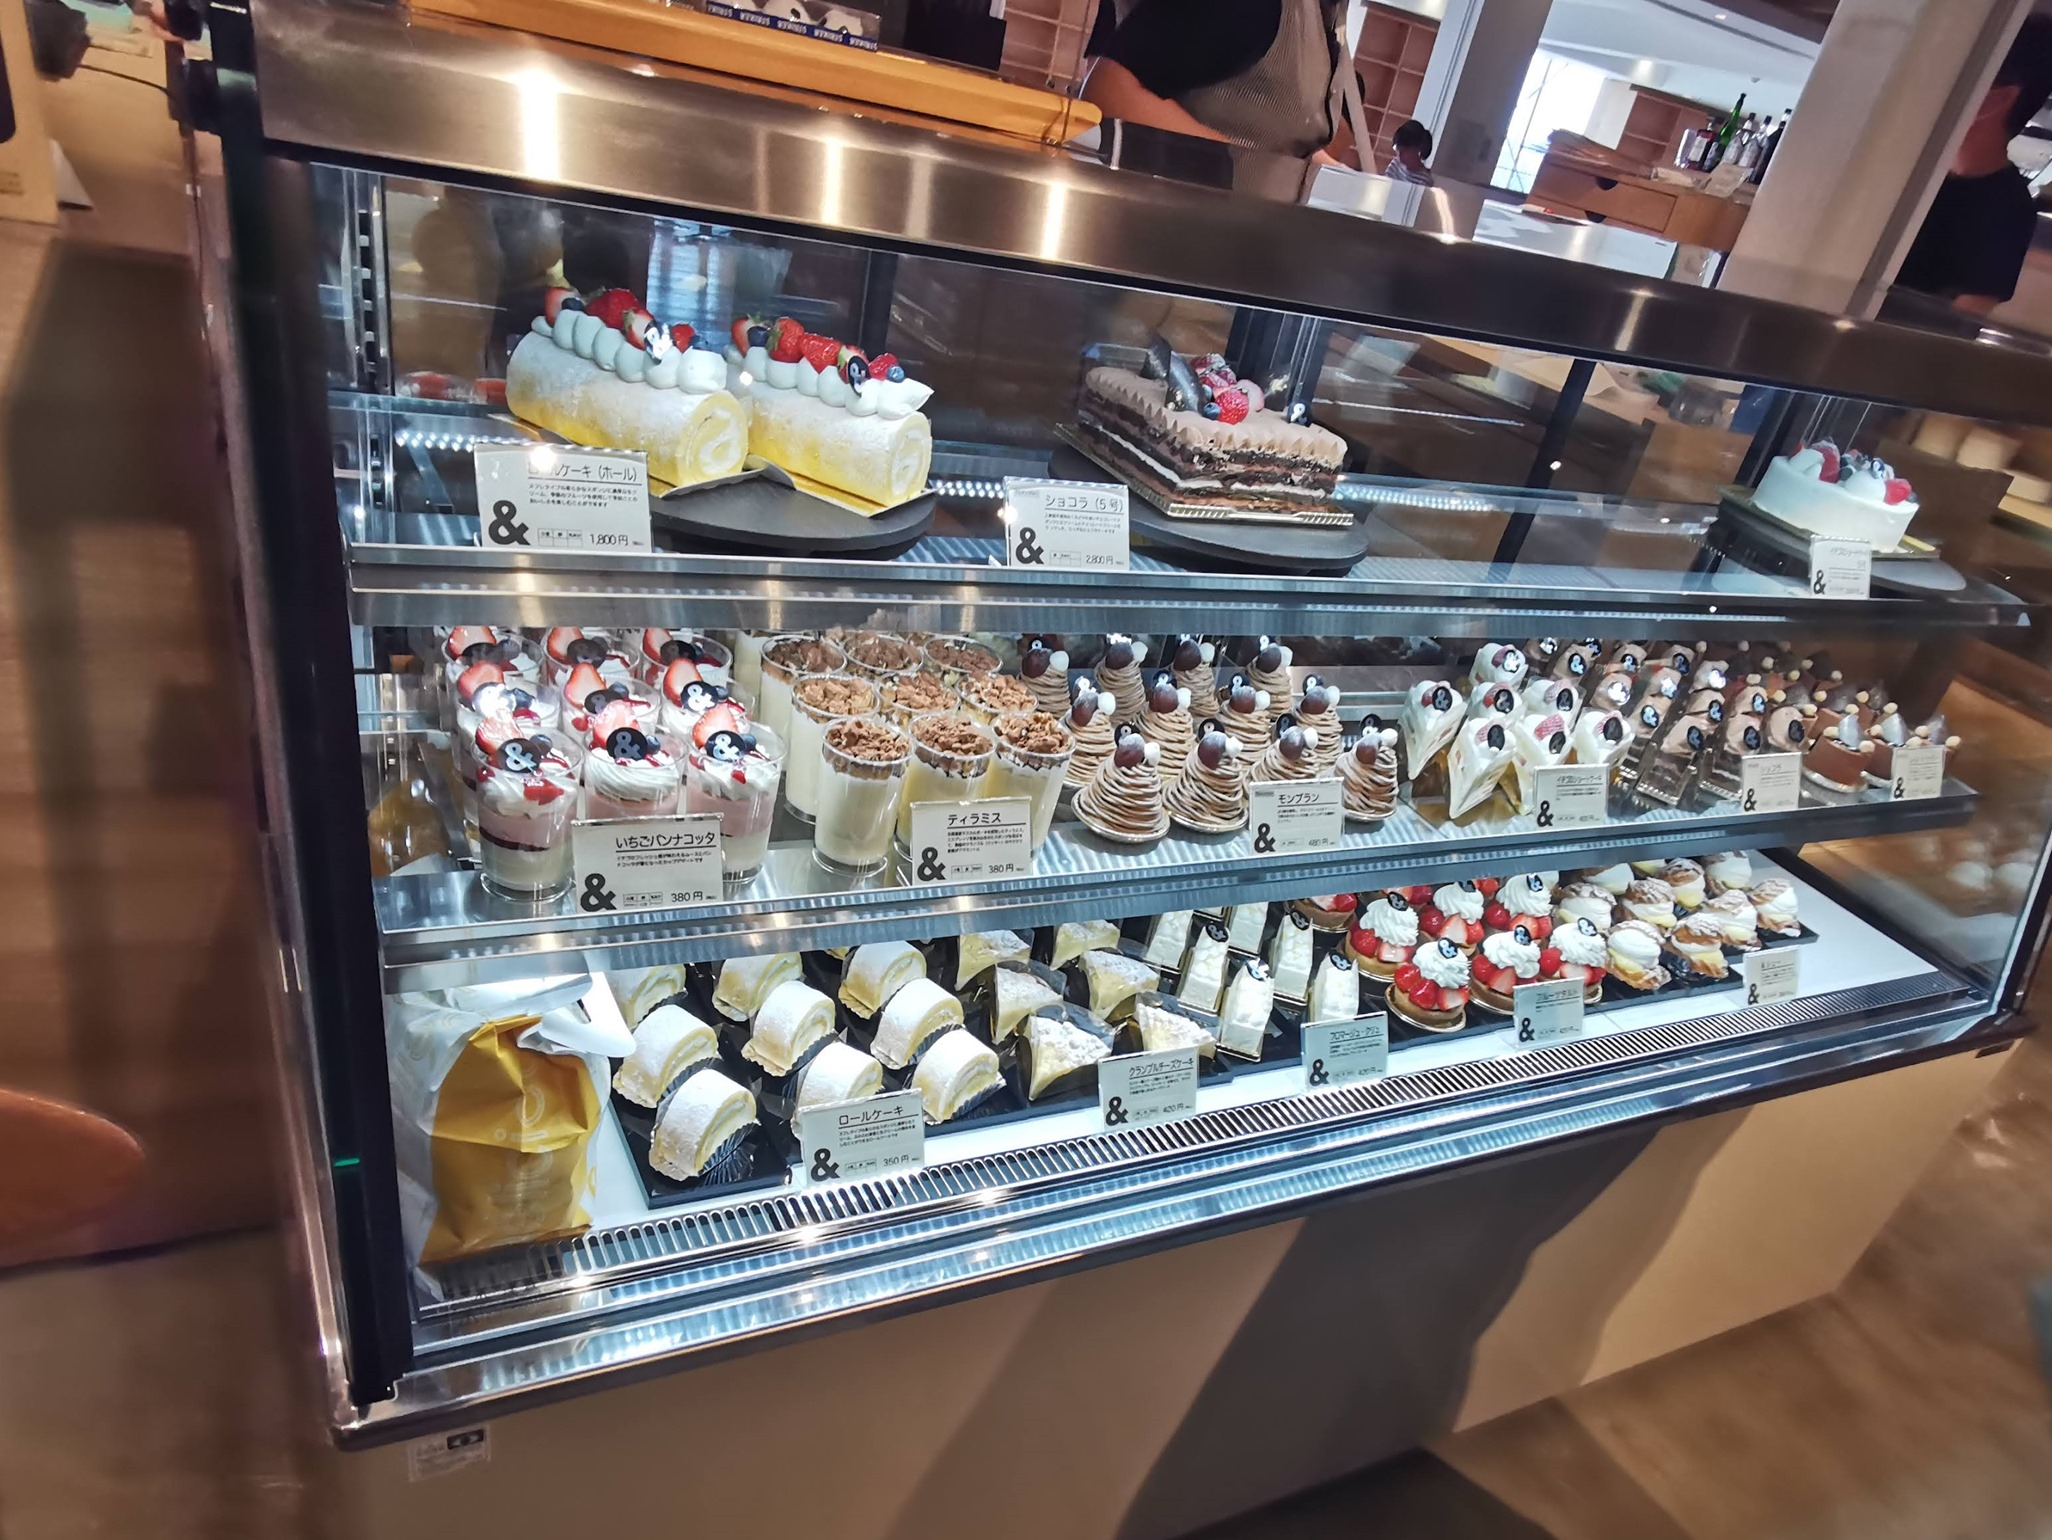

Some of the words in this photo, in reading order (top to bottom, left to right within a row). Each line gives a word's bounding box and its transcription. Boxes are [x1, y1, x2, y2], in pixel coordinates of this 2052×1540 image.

[488, 500, 531, 546] &
[1016, 527, 1044, 564] &
[1813, 570, 1826, 595] &
[1278, 792, 1320, 804] モンブラン
[1744, 788, 1757, 812] &
[1894, 777, 1905, 799] &
[948, 812, 1001, 826] ティラミス
[1537, 800, 1554, 827] &
[616, 832, 716, 849] いちごパンナコッタ
[1254, 823, 1276, 853] &
[917, 847, 946, 881] &
[989, 863, 1014, 874] 380円
[580, 873, 617, 912] &
[671, 891, 703, 902] 380円
[1748, 983, 1760, 1005] &
[1519, 1017, 1535, 1042] &
[1309, 1059, 1330, 1086] &
[839, 1106, 904, 1125] ロールケーキ
[1105, 1096, 1129, 1126] &
[811, 1148, 840, 1182] &
[883, 1155, 910, 1167] 350円
